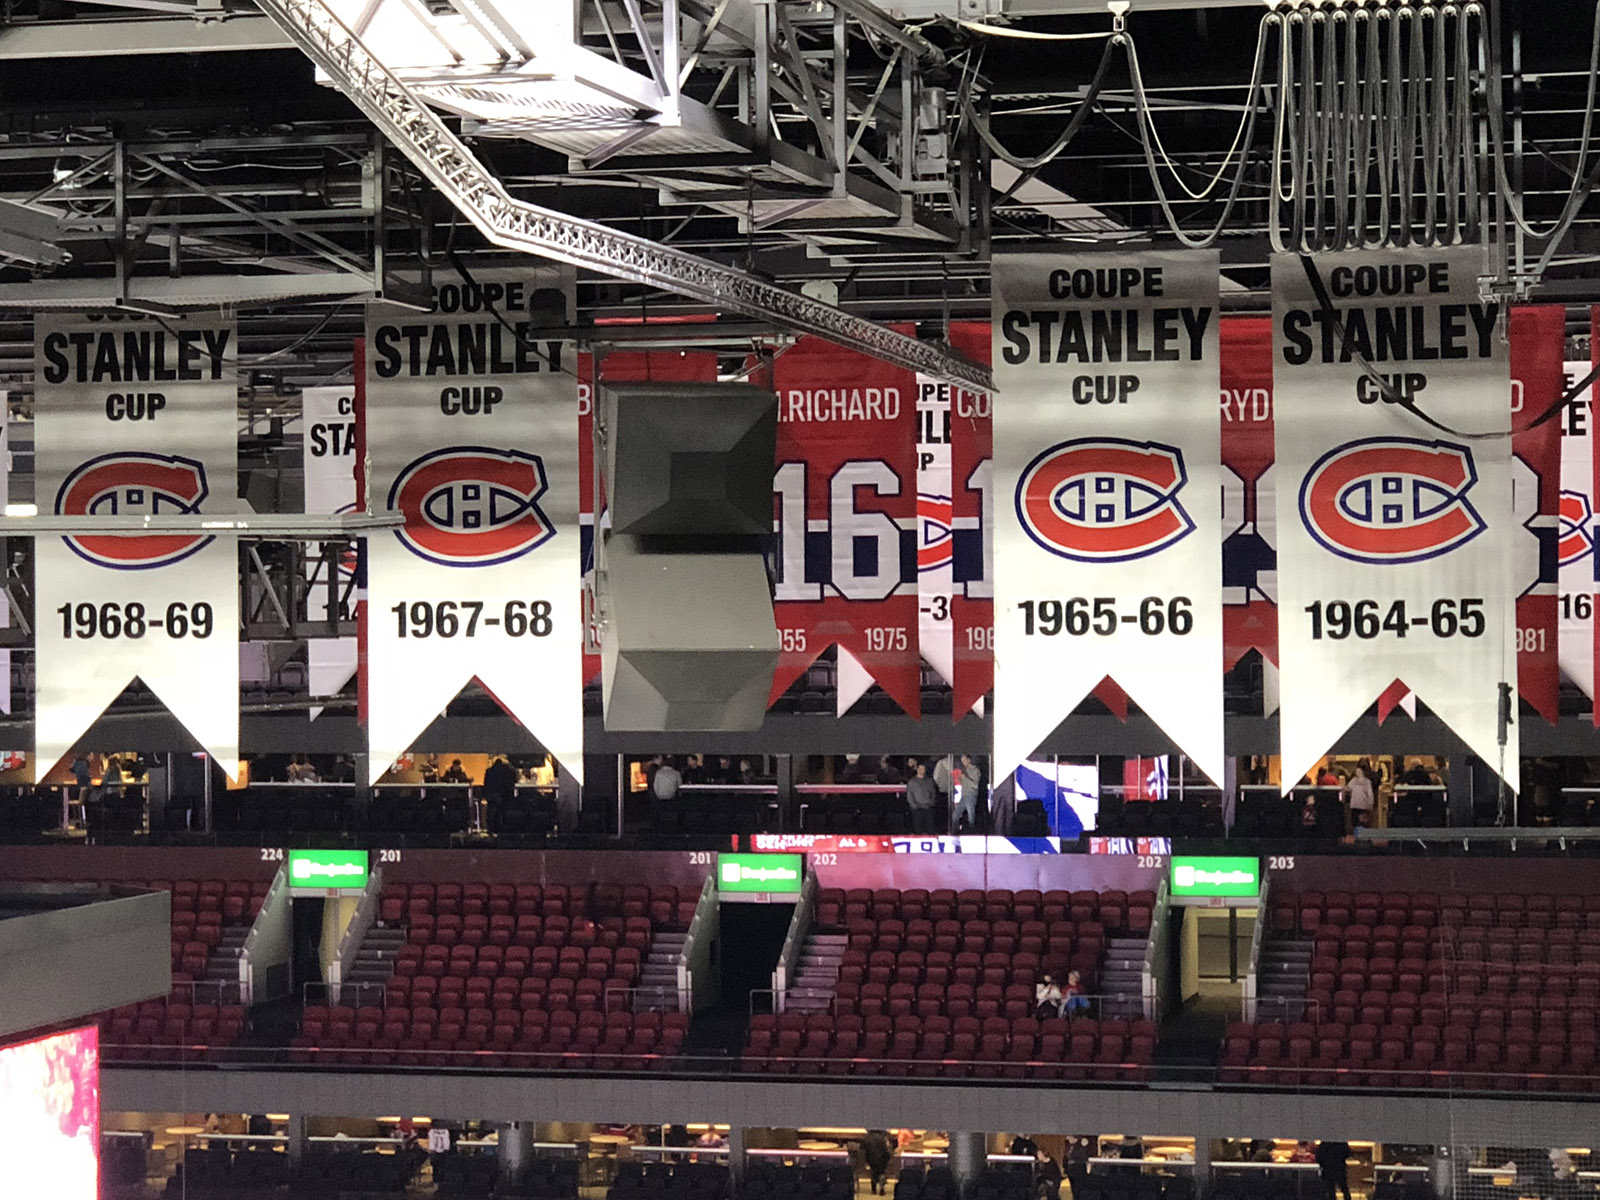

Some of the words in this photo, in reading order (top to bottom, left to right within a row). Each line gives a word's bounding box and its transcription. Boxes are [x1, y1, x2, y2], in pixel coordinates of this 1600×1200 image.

[1049, 267, 1163, 299] COUPE
[1331, 263, 1449, 297] COUPE
[1002, 307, 1212, 365] STANLEY
[1282, 303, 1498, 365] STANLEY
[43, 330, 231, 384] STANLEY
[440, 387, 503, 416] CUP
[1072, 375, 1140, 404] CUP
[1357, 373, 1427, 404] CUP
[105, 393, 166, 421] CUP
[773, 459, 901, 602] 16
[57, 602, 213, 639] 1968-69
[390, 600, 553, 638] 1967-68
[1017, 596, 1193, 636] 1965-66
[1304, 598, 1486, 640] 1964-65
[864, 627, 907, 651] 1975
[261, 848, 284, 861] 224
[380, 849, 401, 862] 201
[690, 852, 711, 864] 201
[814, 853, 837, 865] 202
[1137, 856, 1162, 868] 202
[1269, 856, 1295, 869] 203
